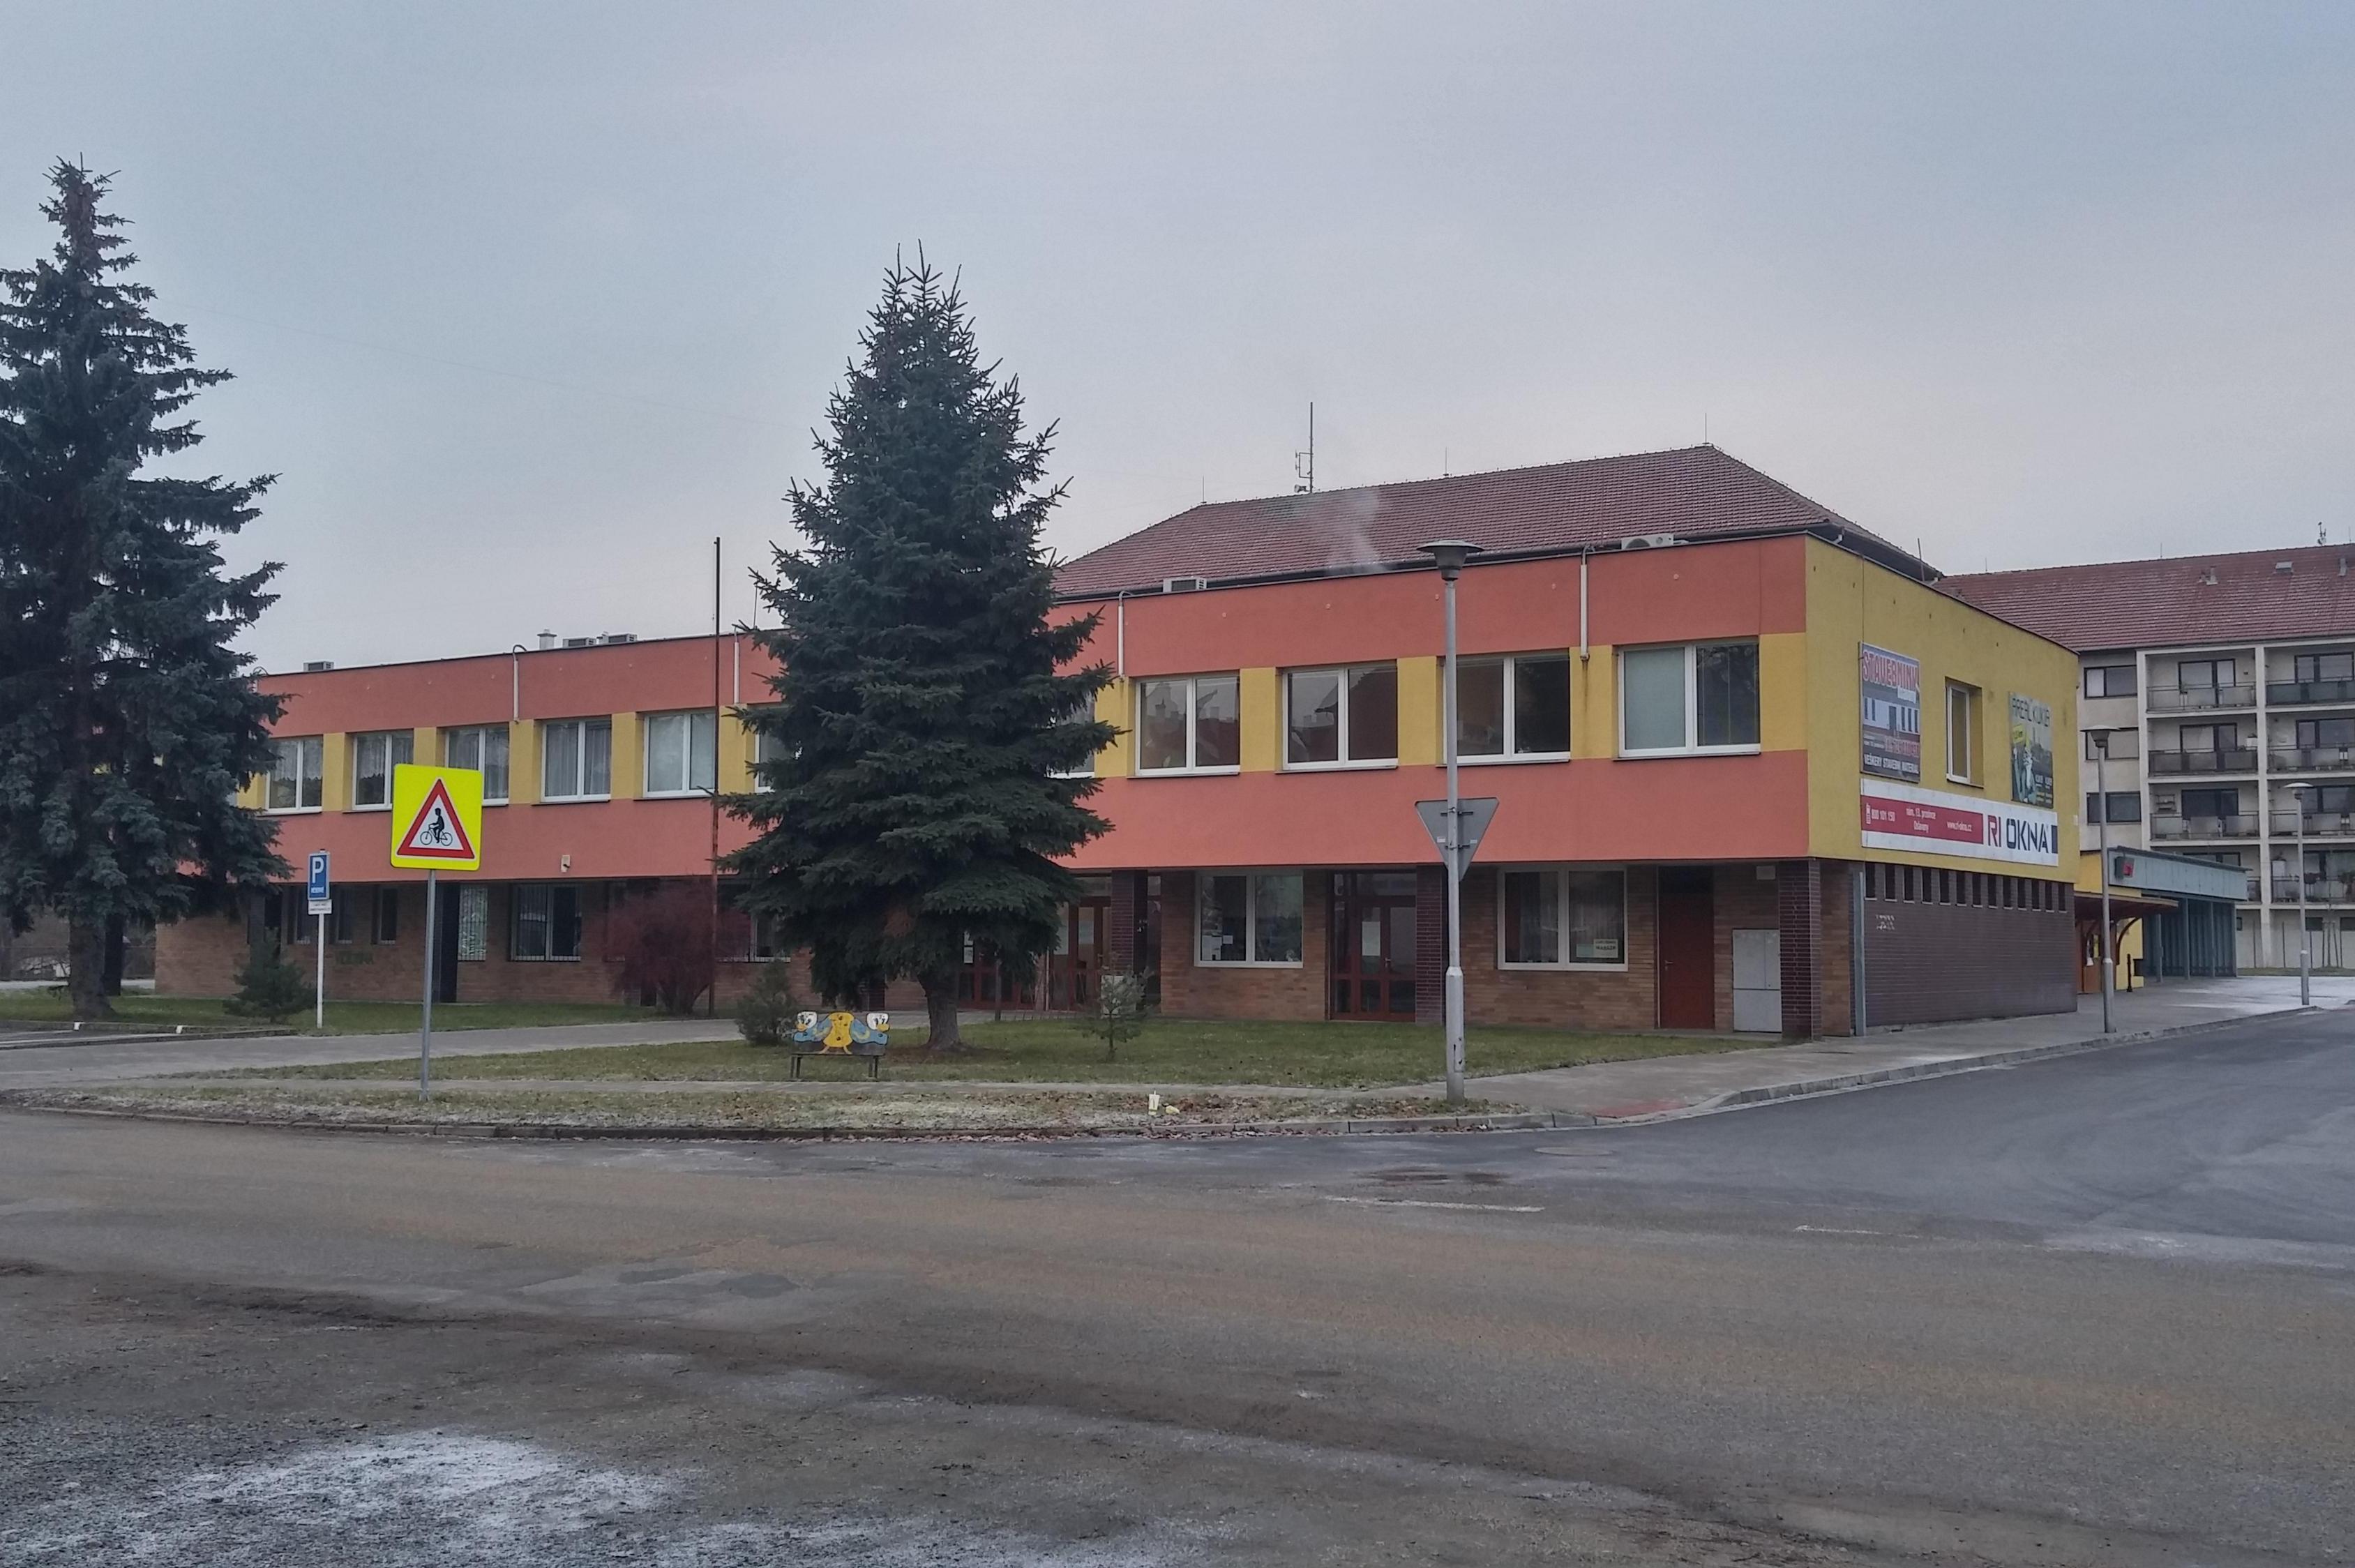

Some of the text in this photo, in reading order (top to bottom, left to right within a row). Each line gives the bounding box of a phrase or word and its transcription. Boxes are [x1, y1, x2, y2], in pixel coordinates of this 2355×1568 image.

[1987, 815, 2049, 853] RI OKNA
[312, 857, 324, 884] P
